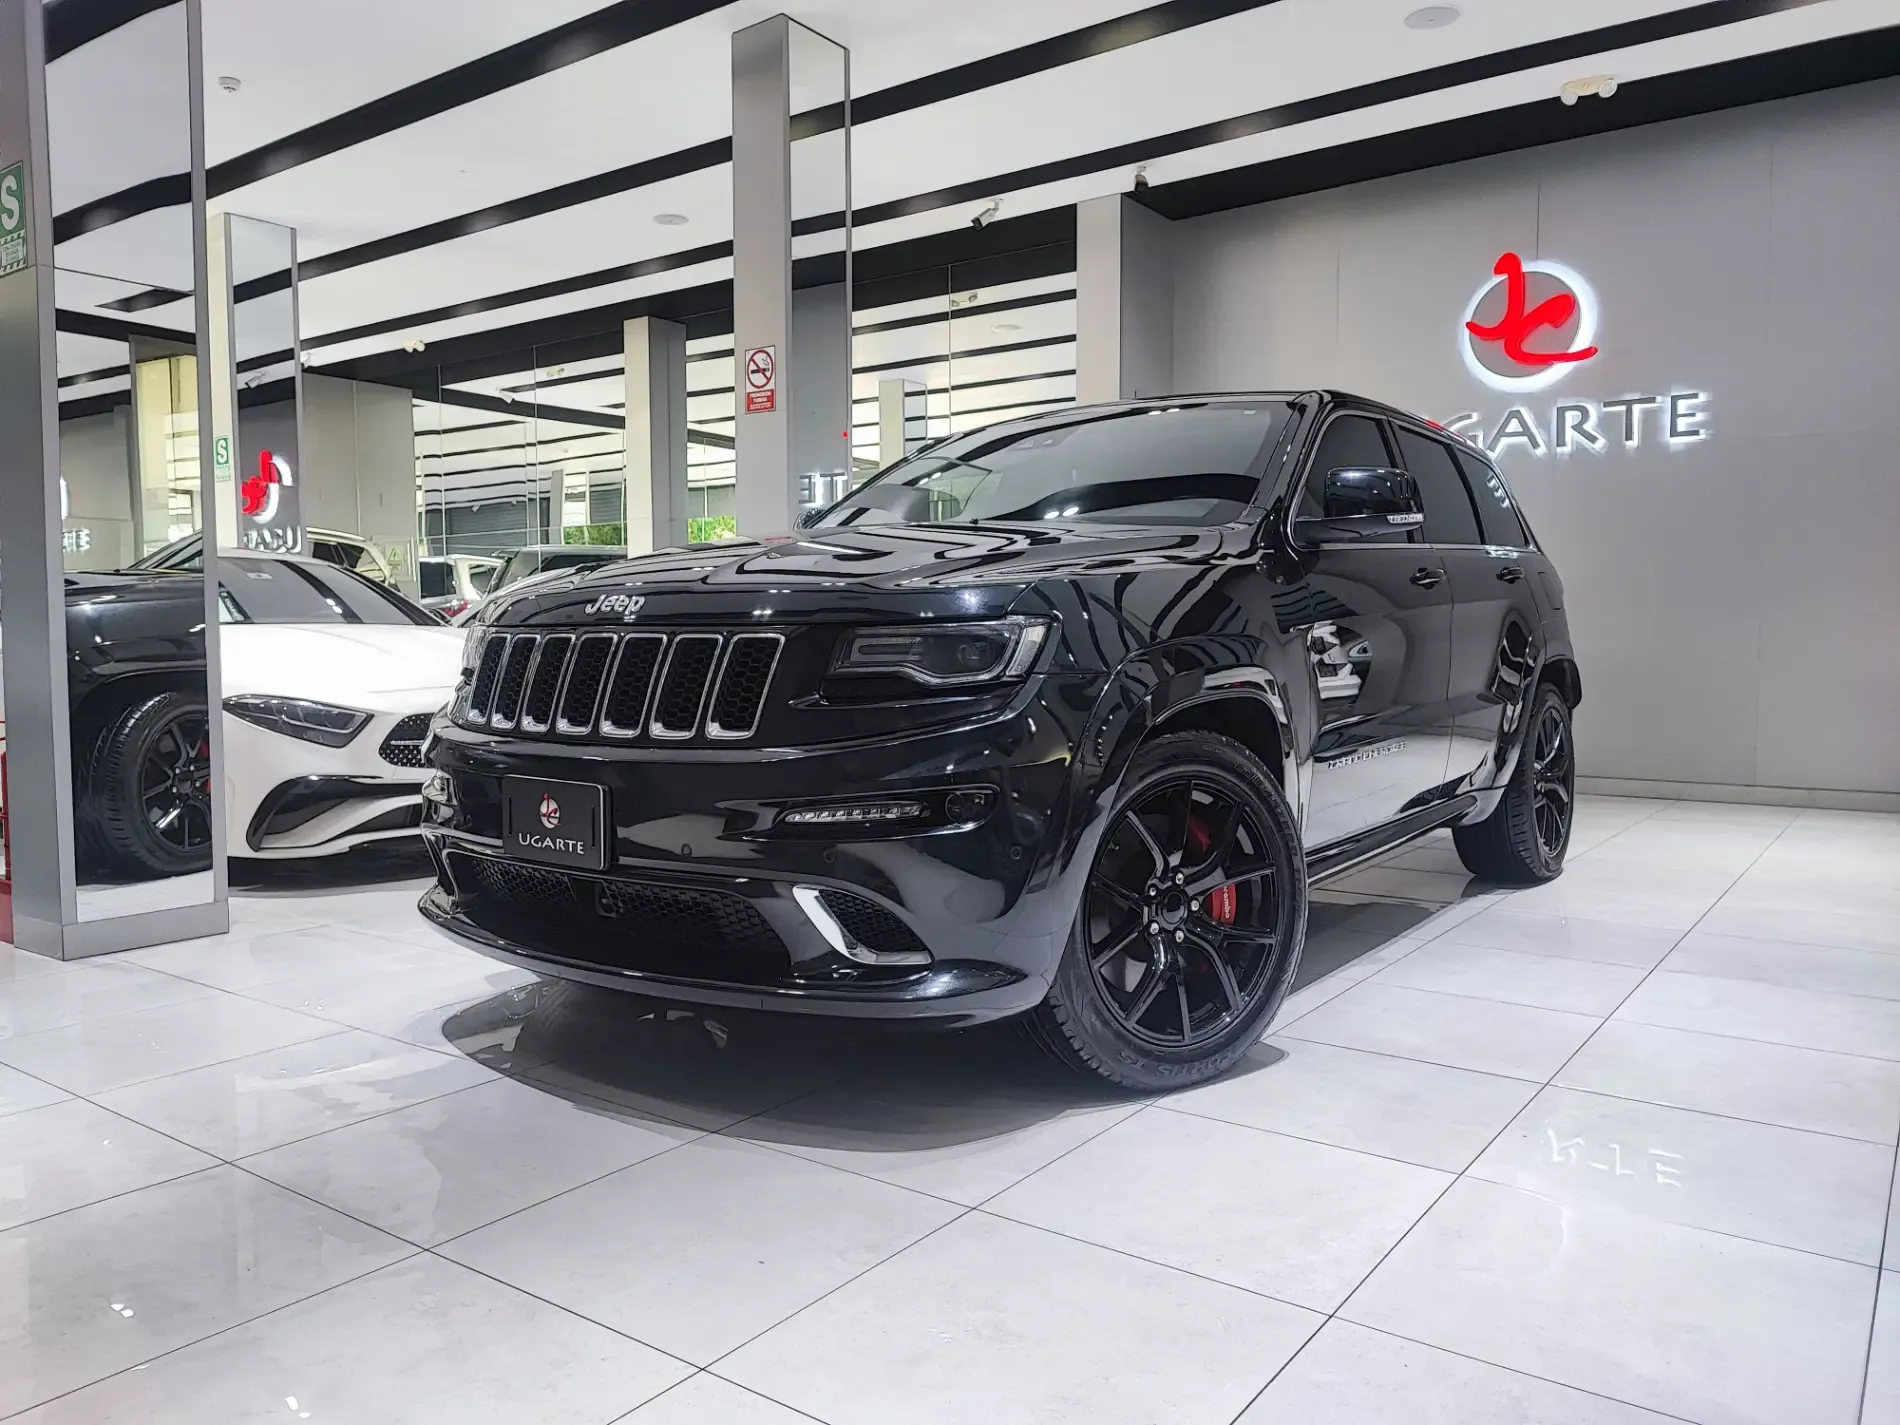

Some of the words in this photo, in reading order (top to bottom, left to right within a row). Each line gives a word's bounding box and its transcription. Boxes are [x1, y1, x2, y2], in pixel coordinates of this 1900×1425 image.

[1, 174, 20, 231] S
[584, 594, 646, 616] Jeep
[518, 832, 585, 855] UGARTE
[1223, 885, 1231, 919] rembo
